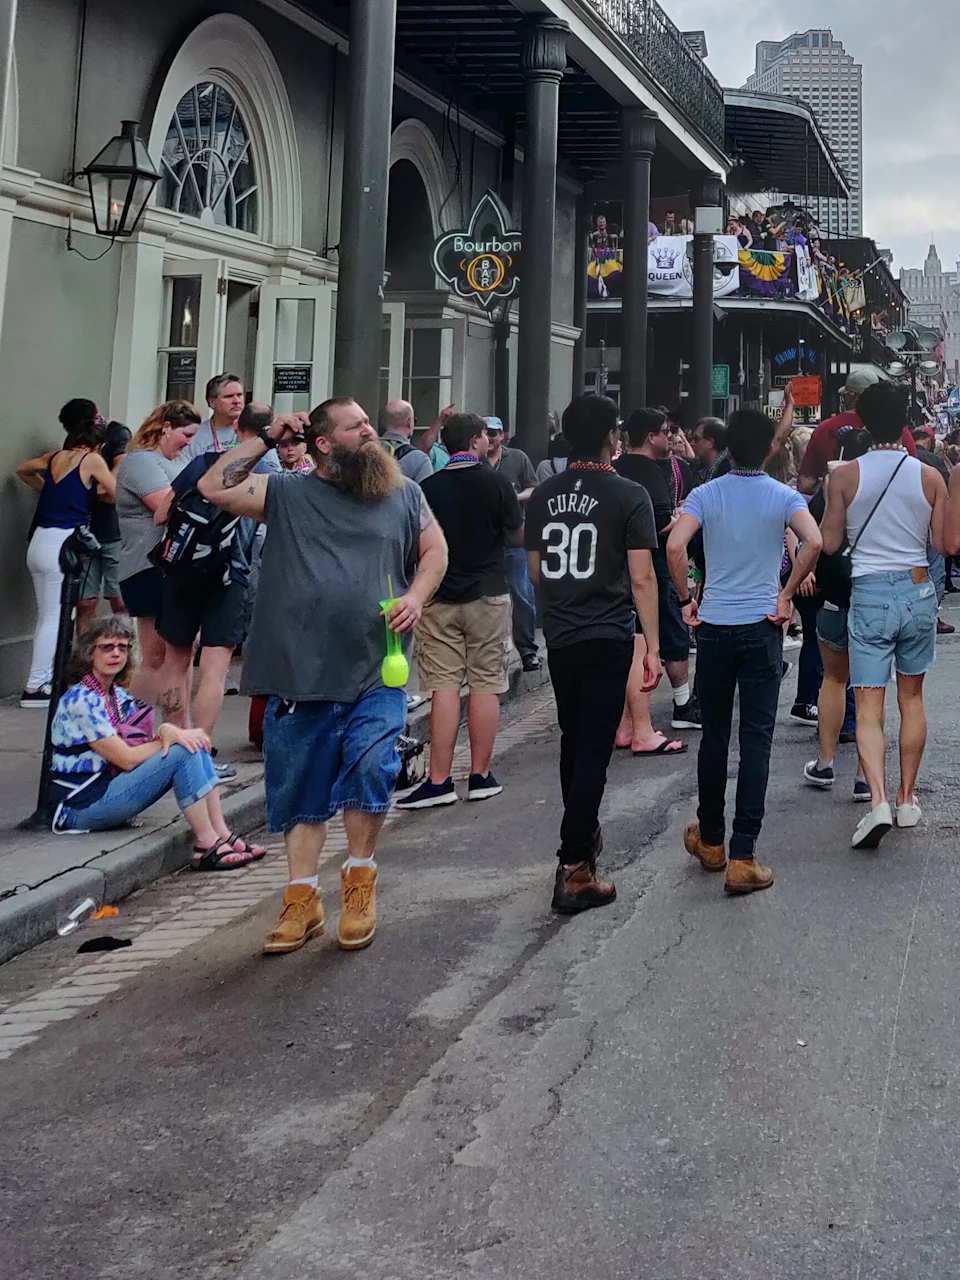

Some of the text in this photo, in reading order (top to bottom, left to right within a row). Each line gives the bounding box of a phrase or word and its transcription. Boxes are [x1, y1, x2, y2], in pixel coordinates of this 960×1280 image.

[453, 236, 522, 252] Bourbon
[481, 259, 490, 287] BAR
[648, 271, 683, 282] QUEEN
[547, 493, 599, 517] CURRY
[541, 522, 598, 580] 30
